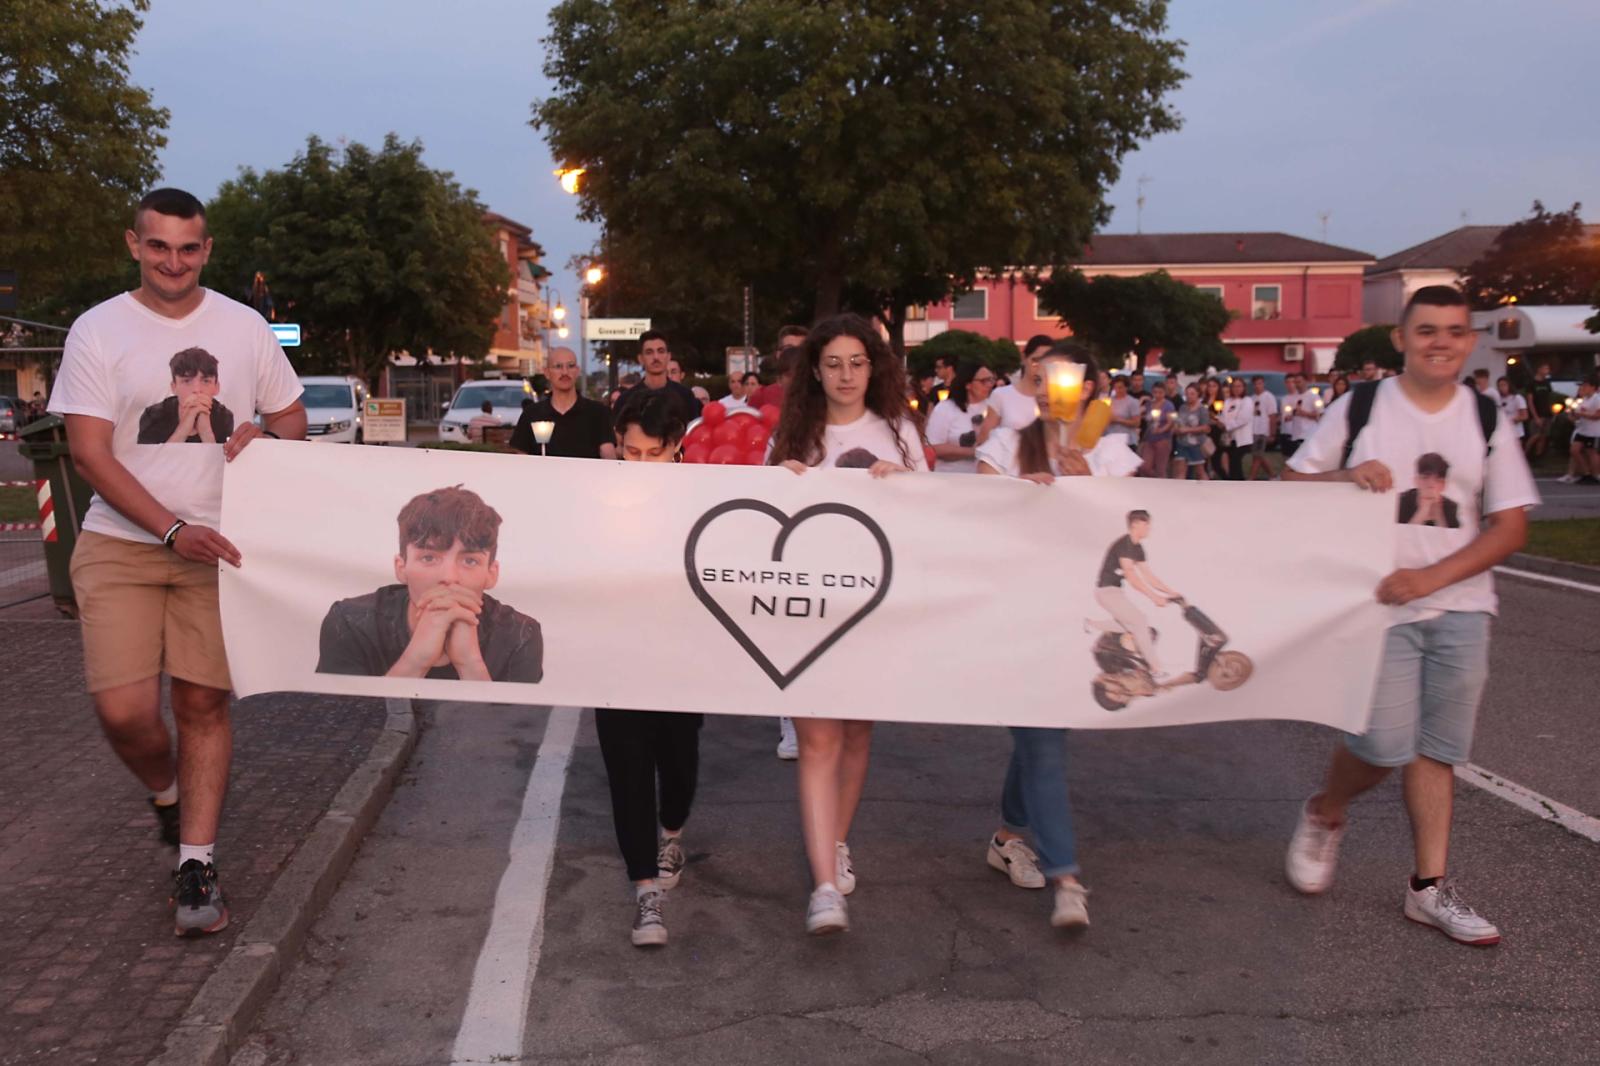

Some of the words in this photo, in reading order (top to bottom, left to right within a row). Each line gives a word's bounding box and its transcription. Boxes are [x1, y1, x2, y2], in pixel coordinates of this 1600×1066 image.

[598, 327, 626, 335] Giovanni
[702, 568, 810, 586] SEMPRE
[822, 574, 876, 589] CON
[751, 595, 826, 618] NOI
